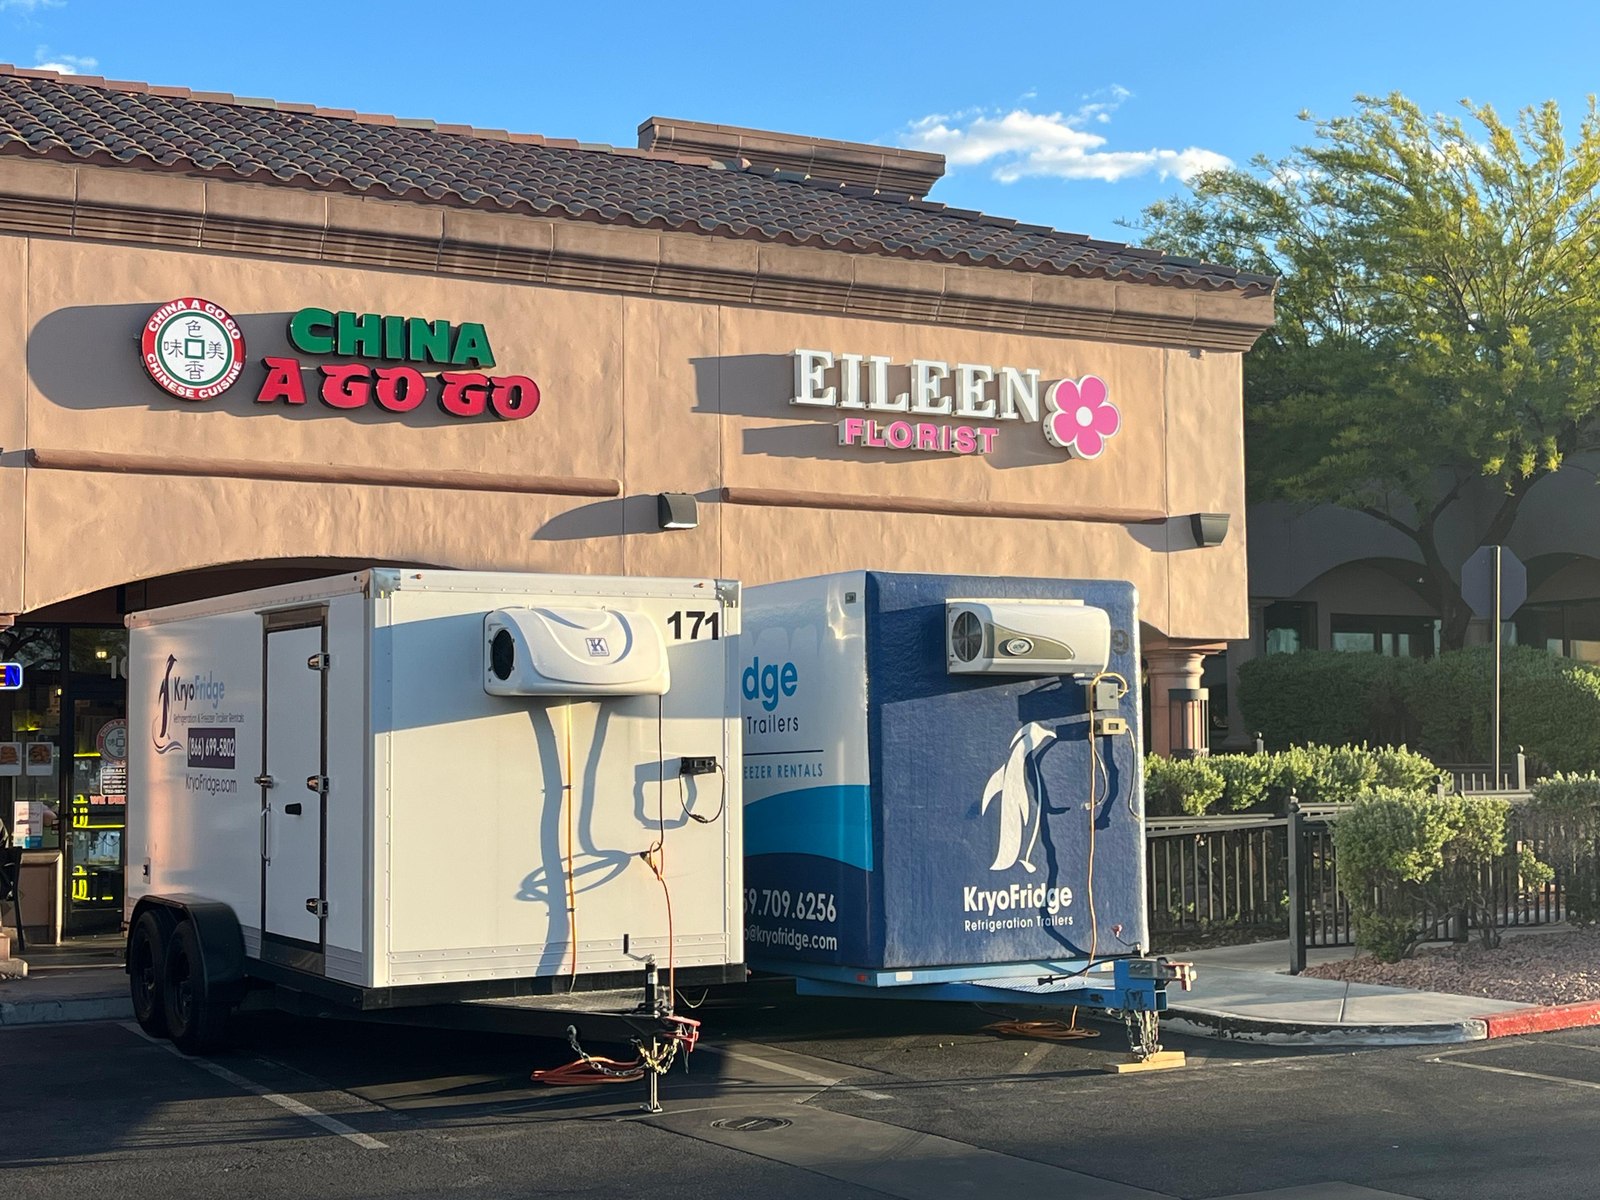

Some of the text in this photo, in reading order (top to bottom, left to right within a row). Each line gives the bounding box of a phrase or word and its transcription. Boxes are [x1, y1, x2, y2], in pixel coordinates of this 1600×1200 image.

[148, 299, 241, 339] CHINA A GO GO
[185, 319, 203, 338] 色
[163, 339, 184, 358] 味
[206, 341, 225, 360] 美
[287, 307, 496, 368] CHINA
[147, 353, 243, 398] CHINESE CUISINE
[185, 360, 204, 380] 香
[253, 356, 541, 420] A GO GO
[789, 347, 1041, 423] EILEEN
[838, 417, 999, 455] FLORIST
[667, 611, 719, 640] 171
[173, 671, 225, 710] KryoFridge
[742, 656, 798, 712] dge
[747, 715, 799, 735] Trailers
[188, 737, 235, 761] (866) 699-5802
[185, 773, 237, 796] KryoFridge.com
[777, 763, 823, 778] RENTALS
[963, 882, 1073, 917] KryoFridge
[964, 915, 1073, 933] Refrigeration Trailers
